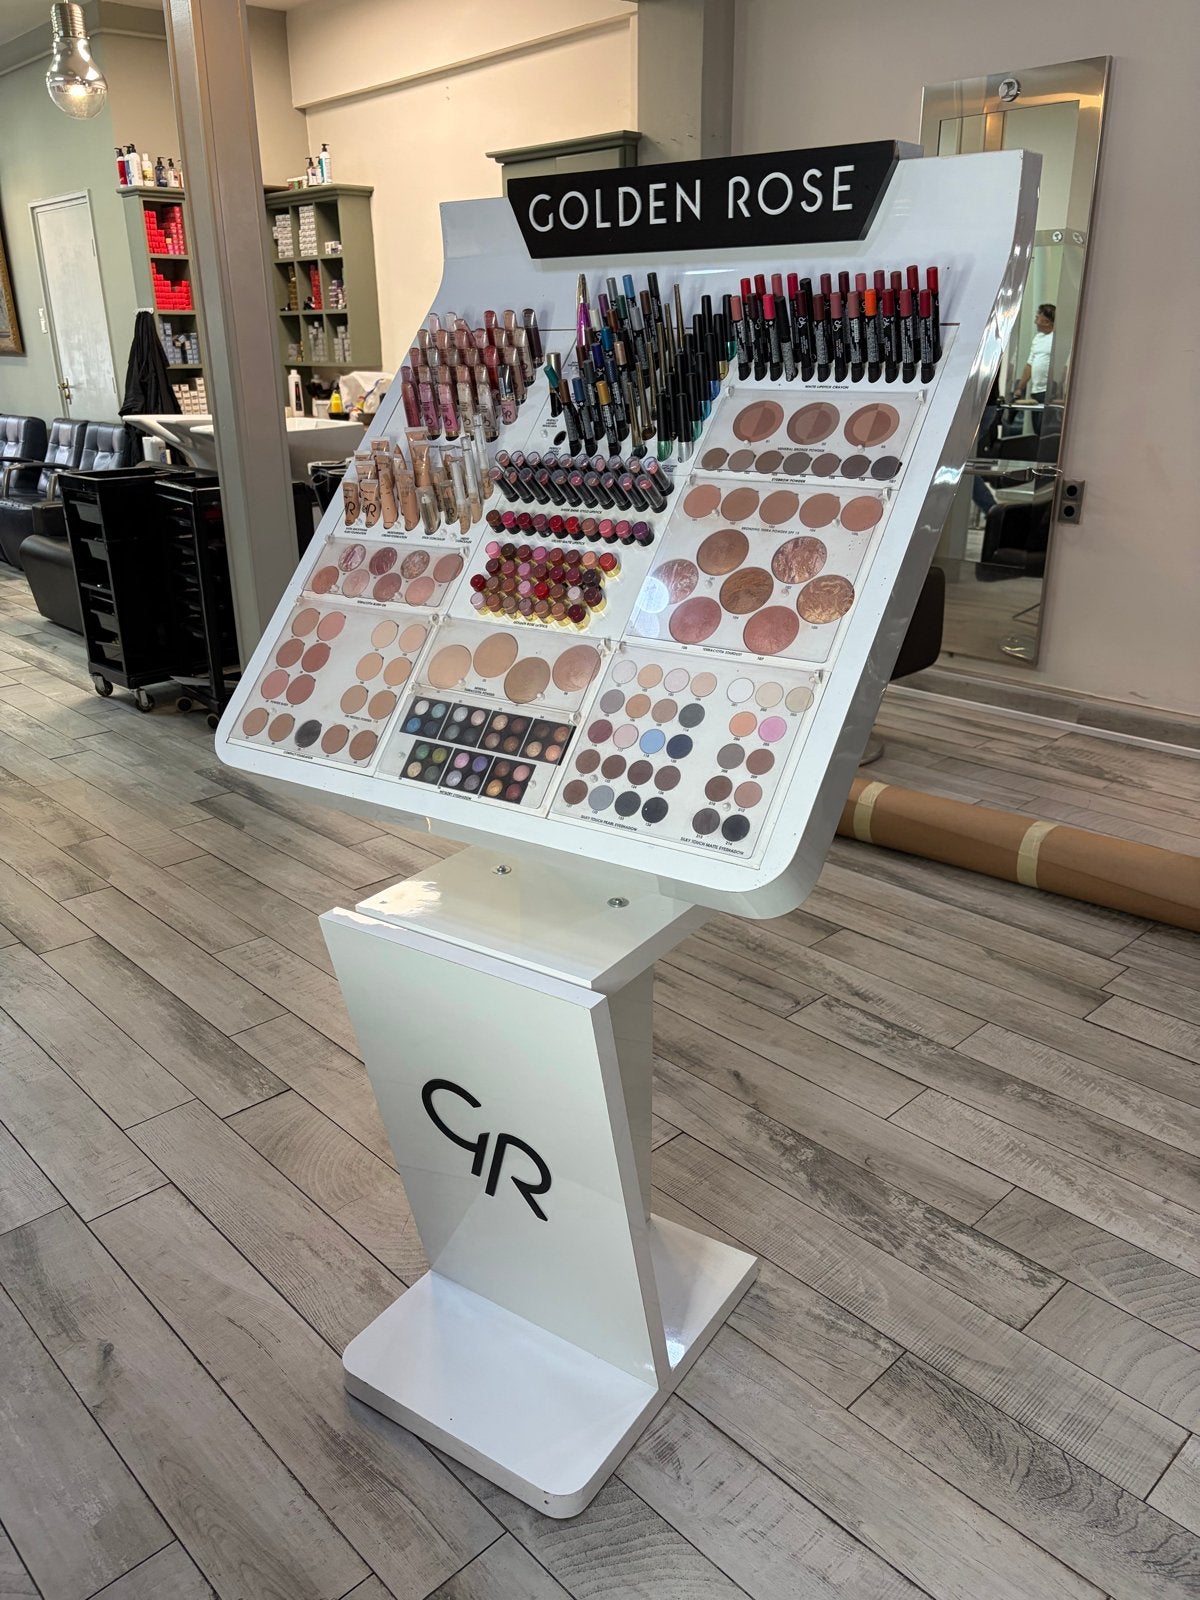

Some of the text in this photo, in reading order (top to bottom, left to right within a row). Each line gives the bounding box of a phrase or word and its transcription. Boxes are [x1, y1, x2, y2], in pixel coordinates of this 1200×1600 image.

[528, 164, 855, 233] GOLDEN ROSE
[421, 1078, 552, 1222] GR
